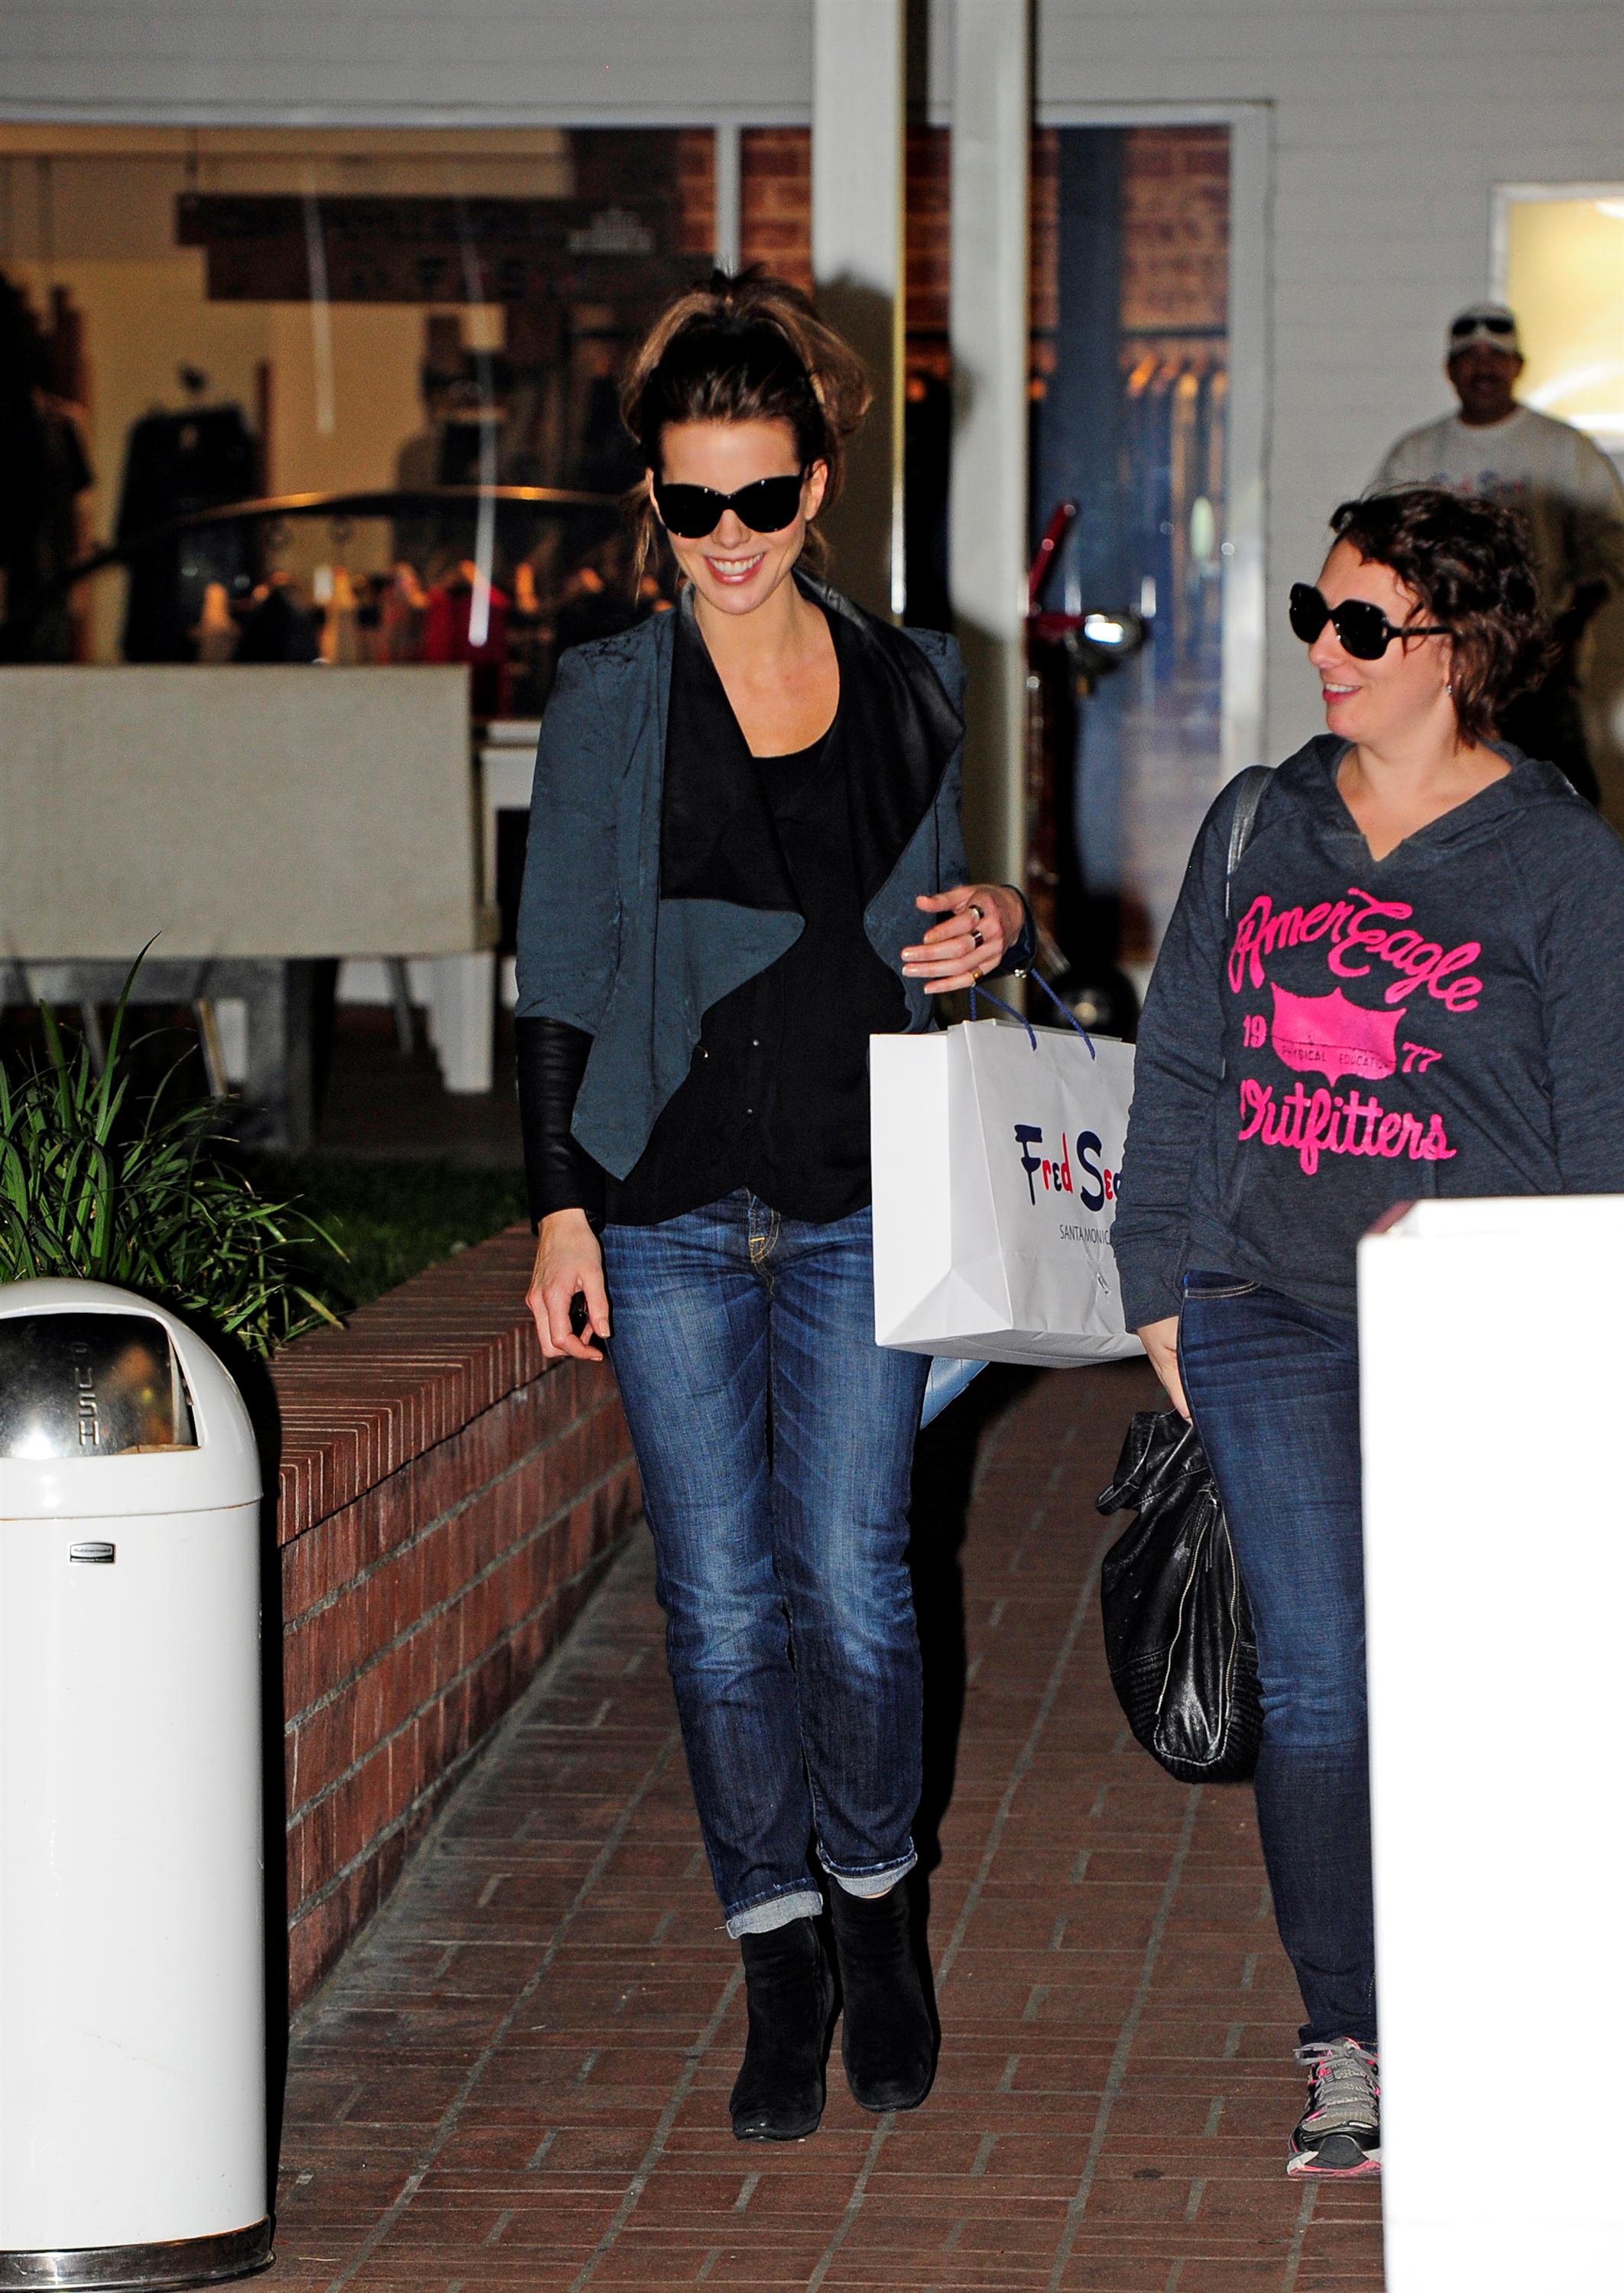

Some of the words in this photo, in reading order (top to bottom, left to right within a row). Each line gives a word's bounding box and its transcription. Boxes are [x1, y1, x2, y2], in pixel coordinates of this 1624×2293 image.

[1243, 1015, 1267, 1047] 19
[1402, 1042, 1443, 1072] 77
[1339, 1053, 1389, 1070] EDUCAT
[1239, 1078, 1457, 1175] Outfitters
[1014, 1124, 1073, 1205] Fred
[1059, 1224, 1084, 1242] SANTA
[1084, 1228, 1111, 1245] MONIC
[73, 1341, 100, 1446] PUSH
